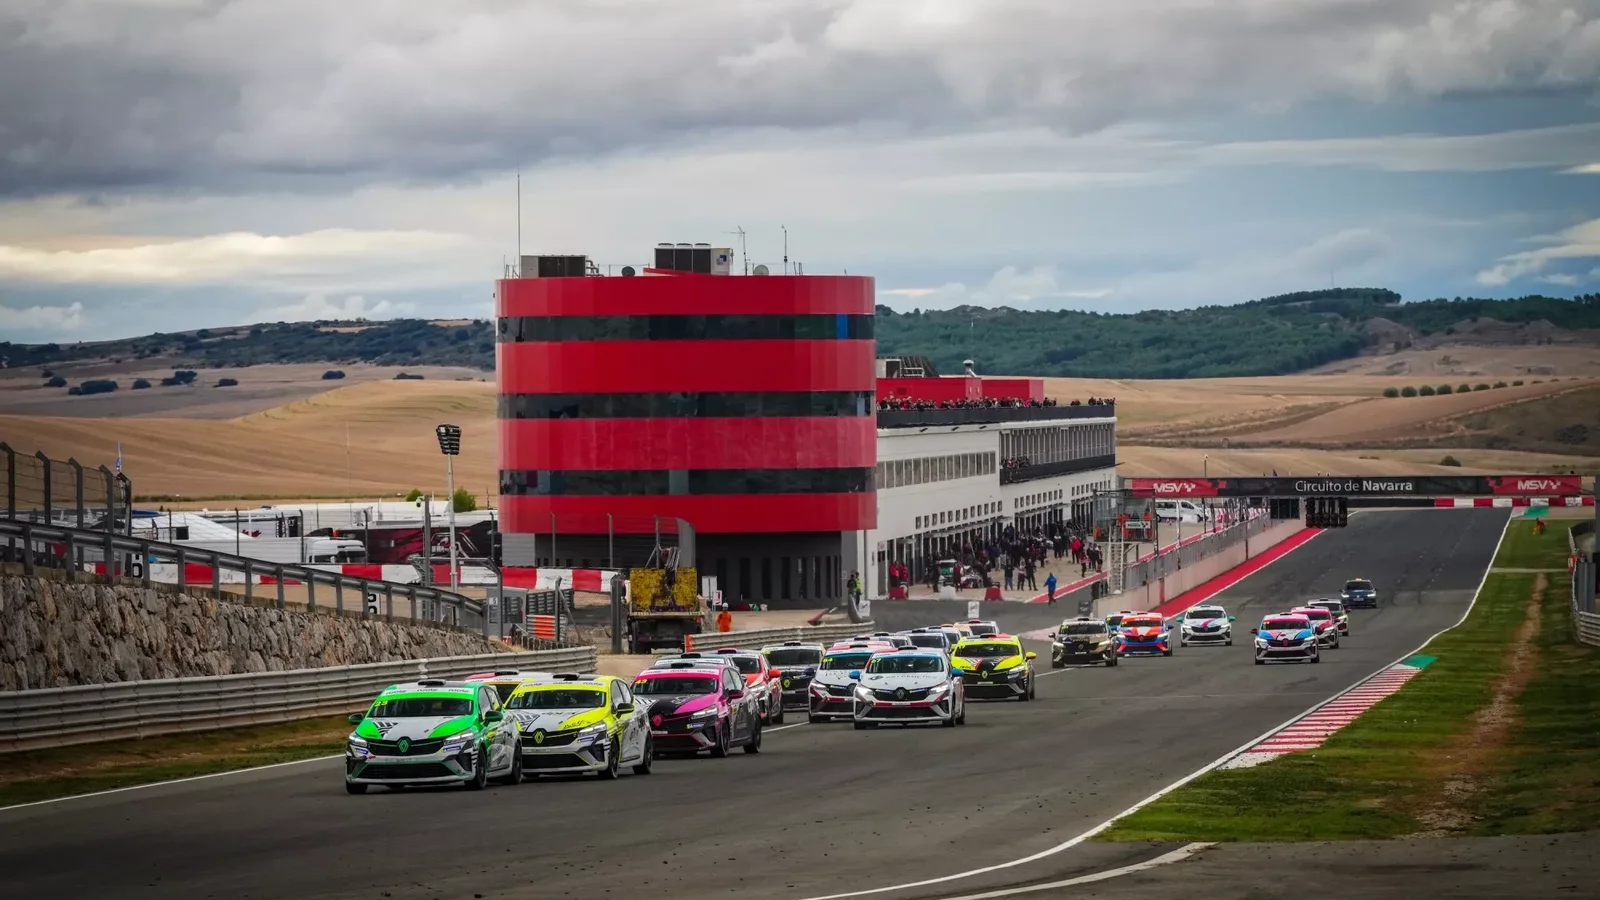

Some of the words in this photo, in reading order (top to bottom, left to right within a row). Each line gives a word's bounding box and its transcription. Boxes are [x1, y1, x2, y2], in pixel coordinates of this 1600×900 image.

[1153, 482, 1183, 493] MSV
[1295, 480, 1342, 492] Circuito
[1344, 480, 1359, 491] de
[1362, 480, 1413, 491] Navarra
[1517, 480, 1548, 490] MSV
